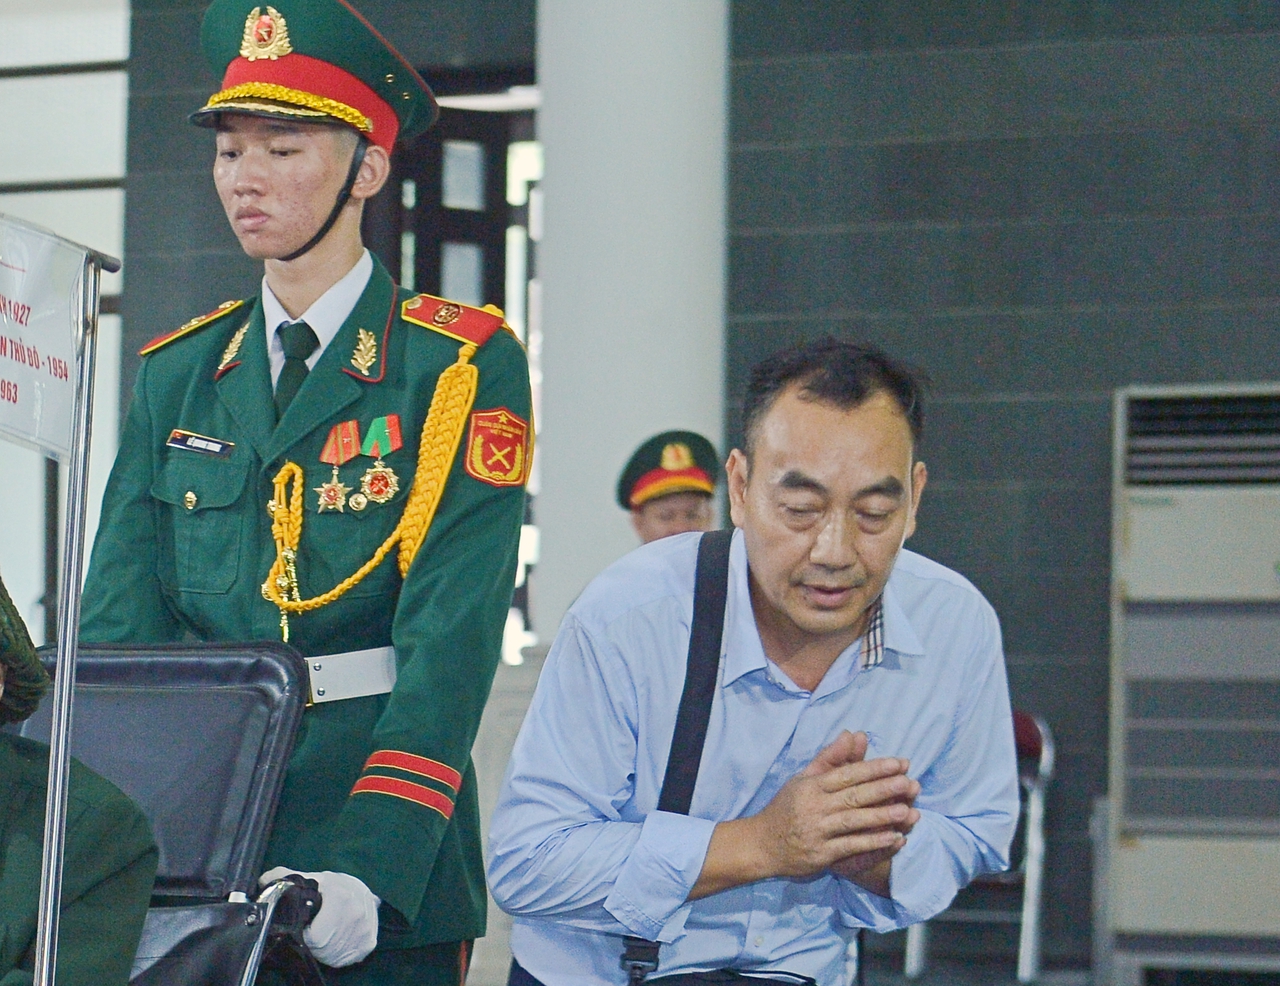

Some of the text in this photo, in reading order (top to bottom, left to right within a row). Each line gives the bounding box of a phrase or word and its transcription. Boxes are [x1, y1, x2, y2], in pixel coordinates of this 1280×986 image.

[8, 299, 31, 327] 1927
[9, 337, 26, 364] THỦ
[47, 355, 69, 382] 1954
